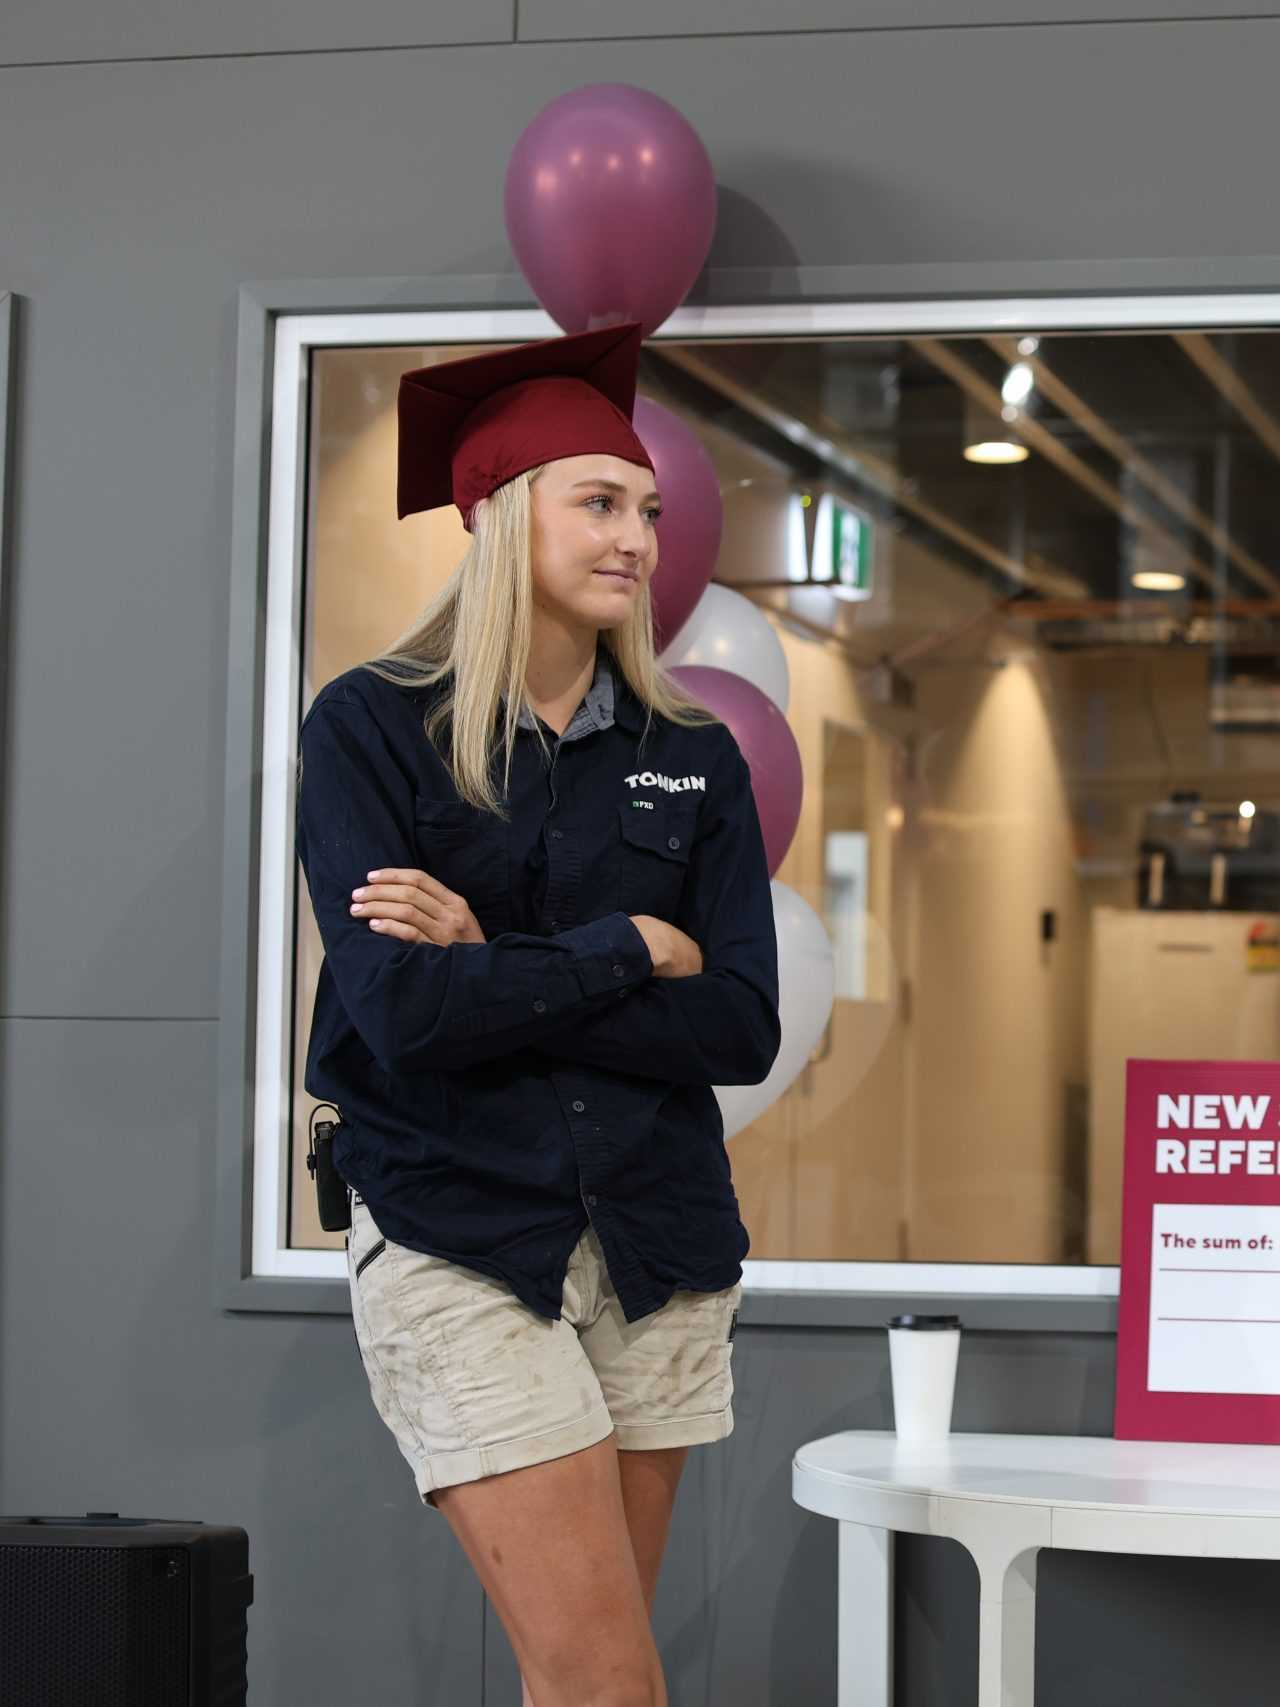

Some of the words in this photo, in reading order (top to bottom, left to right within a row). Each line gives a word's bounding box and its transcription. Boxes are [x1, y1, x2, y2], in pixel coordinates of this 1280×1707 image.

[624, 771, 706, 793] TONKIN
[1156, 1094, 1271, 1130] NEW
[1160, 1233, 1197, 1249] The
[1202, 1236, 1242, 1250] sum
[1247, 1234, 1274, 1250] of:
